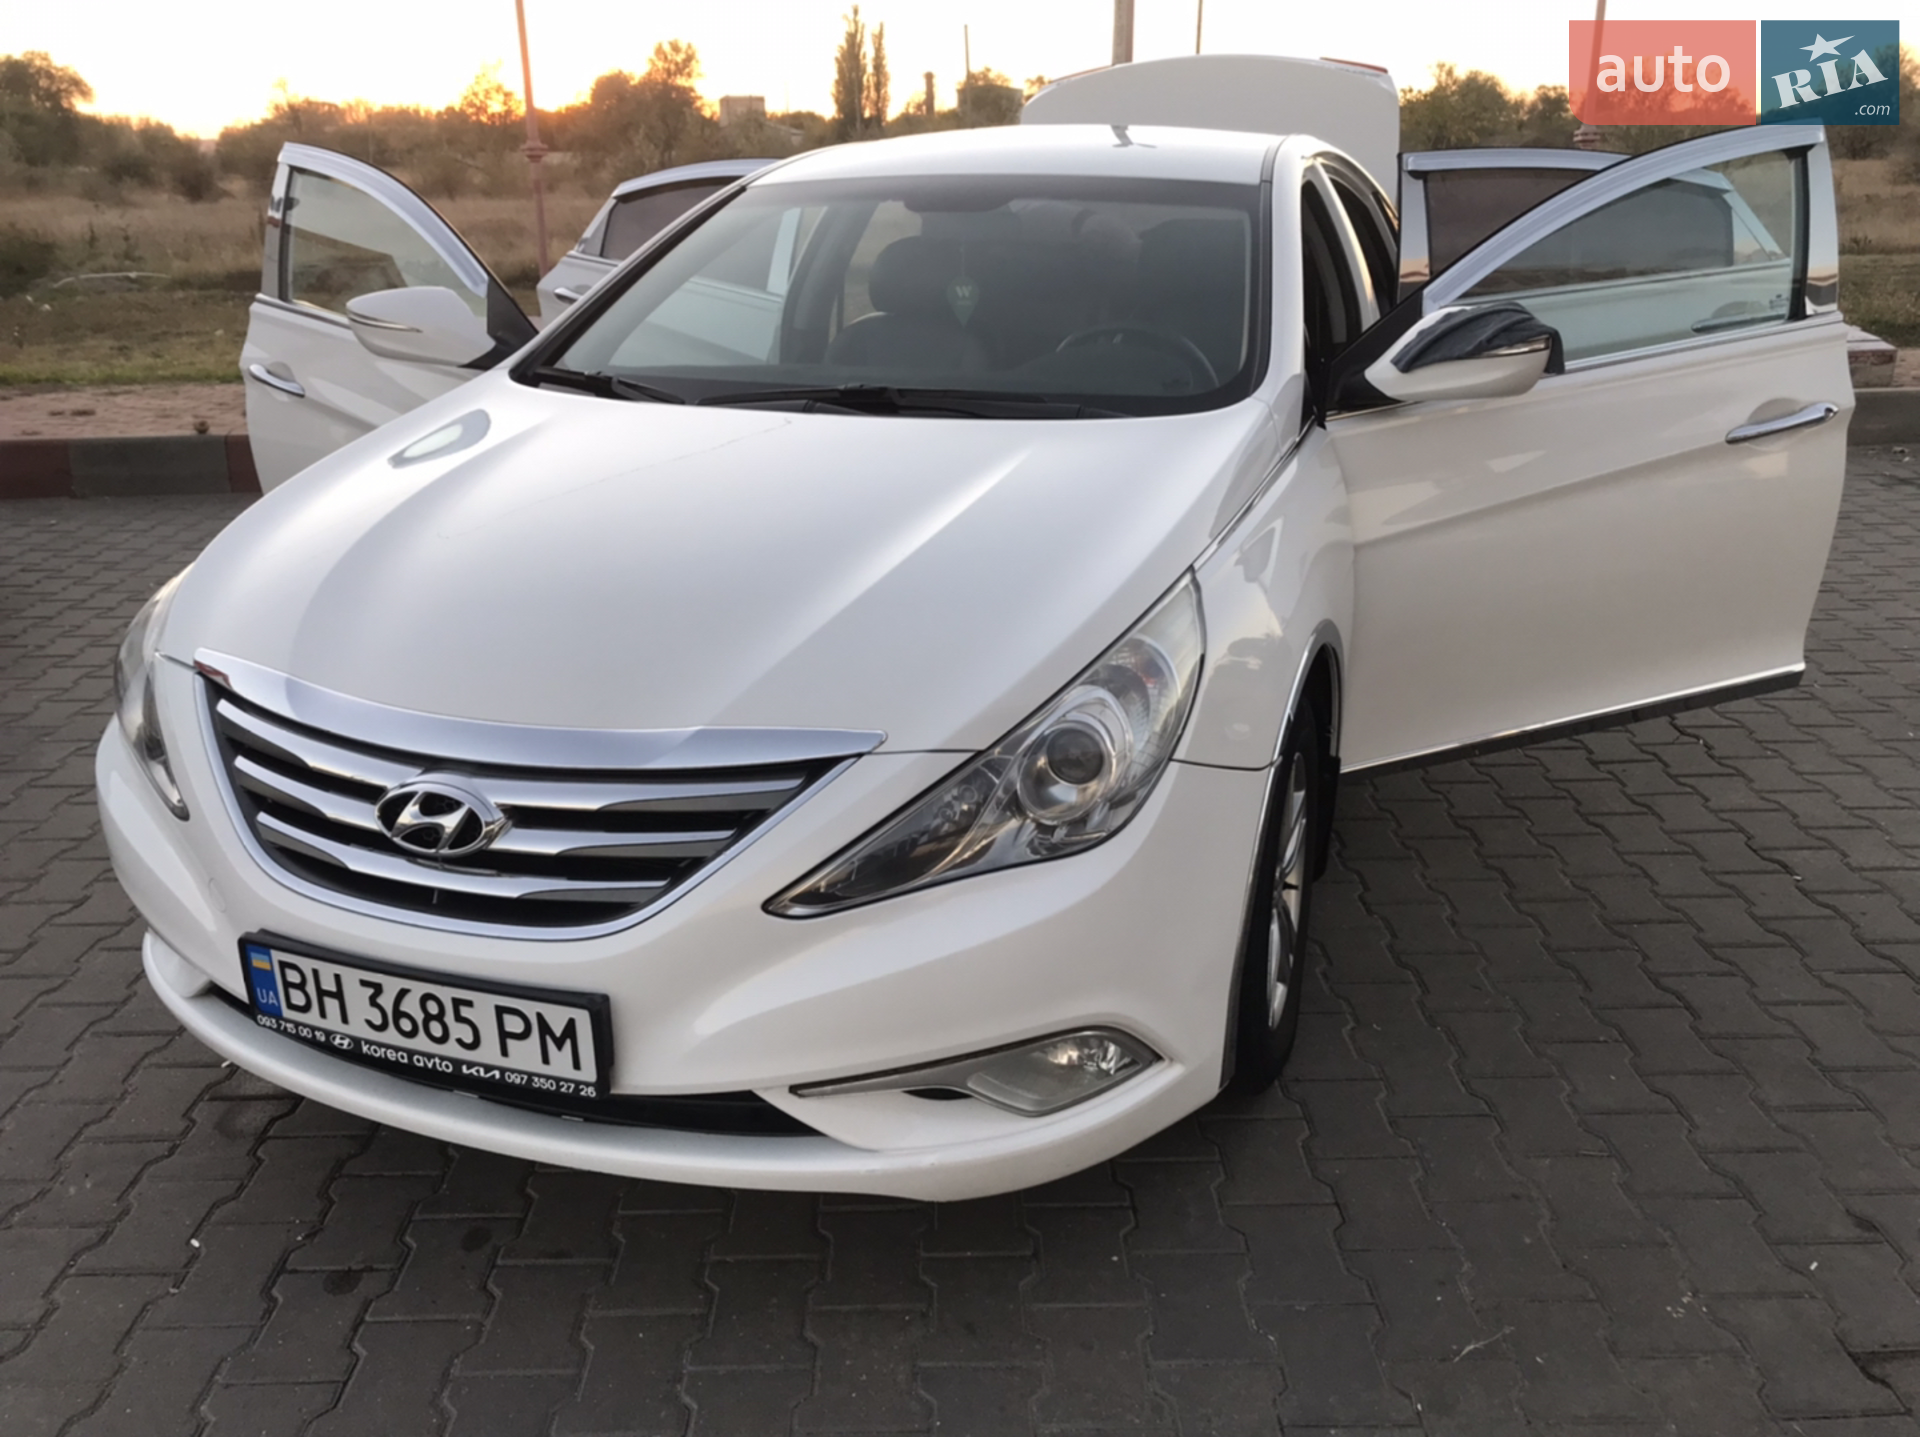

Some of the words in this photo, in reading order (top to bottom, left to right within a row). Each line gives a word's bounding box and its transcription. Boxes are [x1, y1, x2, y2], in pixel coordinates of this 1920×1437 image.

[257, 987, 279, 1008] UA
[278, 959, 350, 1026] BH
[359, 978, 481, 1051] 3685
[494, 1003, 582, 1072] PM
[257, 1014, 277, 1029] 093
[298, 1026, 312, 1038] 00
[361, 1040, 409, 1064] korea
[413, 1055, 454, 1074] avto
[504, 1071, 528, 1085] 097
[531, 1076, 557, 1090] 350
[559, 1081, 575, 1094] 27
[579, 1085, 597, 1098] 26
